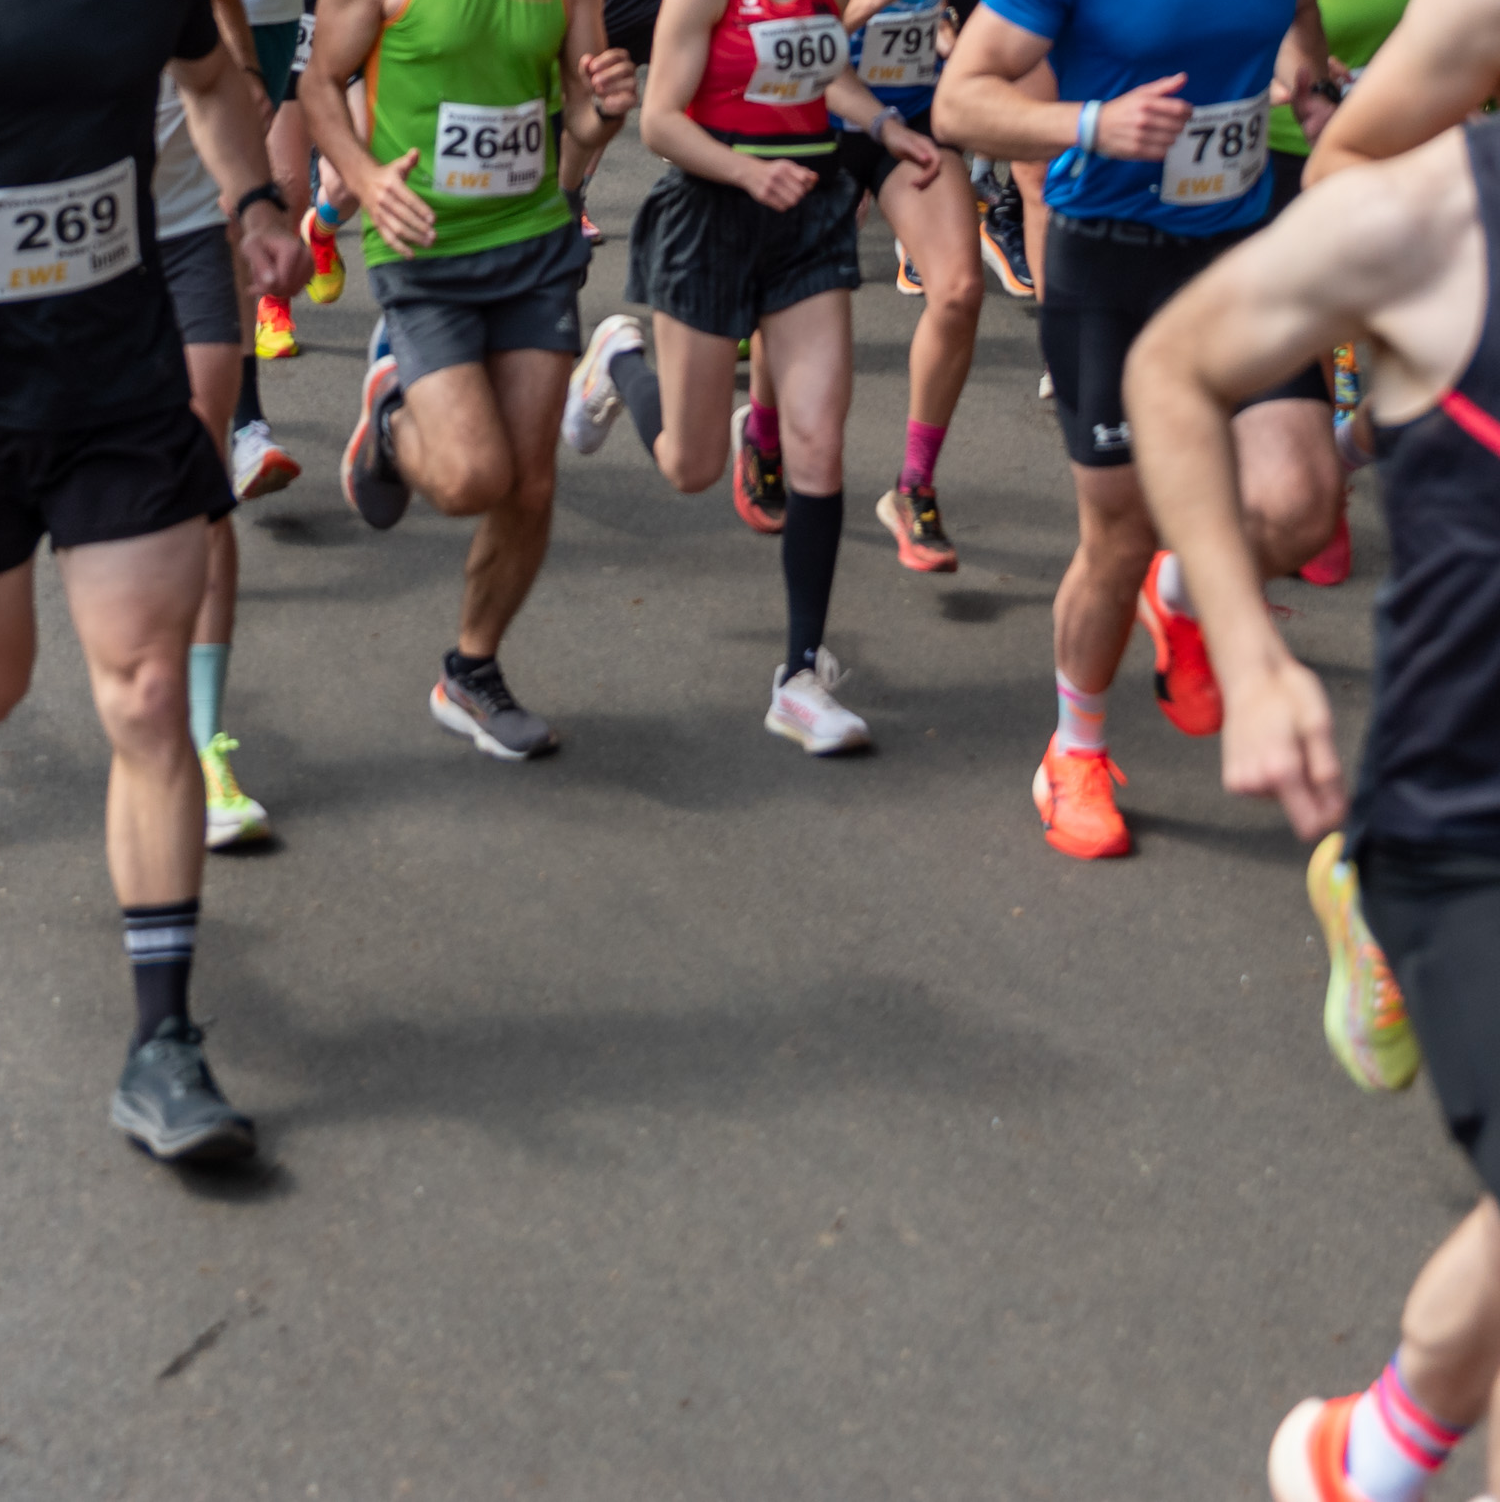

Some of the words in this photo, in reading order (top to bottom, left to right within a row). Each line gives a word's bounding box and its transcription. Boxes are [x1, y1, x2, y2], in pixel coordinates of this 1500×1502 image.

[774, 33, 836, 72] 960
[881, 22, 937, 57] 791
[760, 81, 801, 97] EWE
[867, 65, 906, 81] EWE
[441, 121, 542, 159] 2640
[1188, 113, 1262, 164] 789
[445, 171, 492, 189] EWE
[1176, 174, 1226, 196] EWE
[14, 194, 118, 252] 269
[9, 261, 69, 290] EWE
